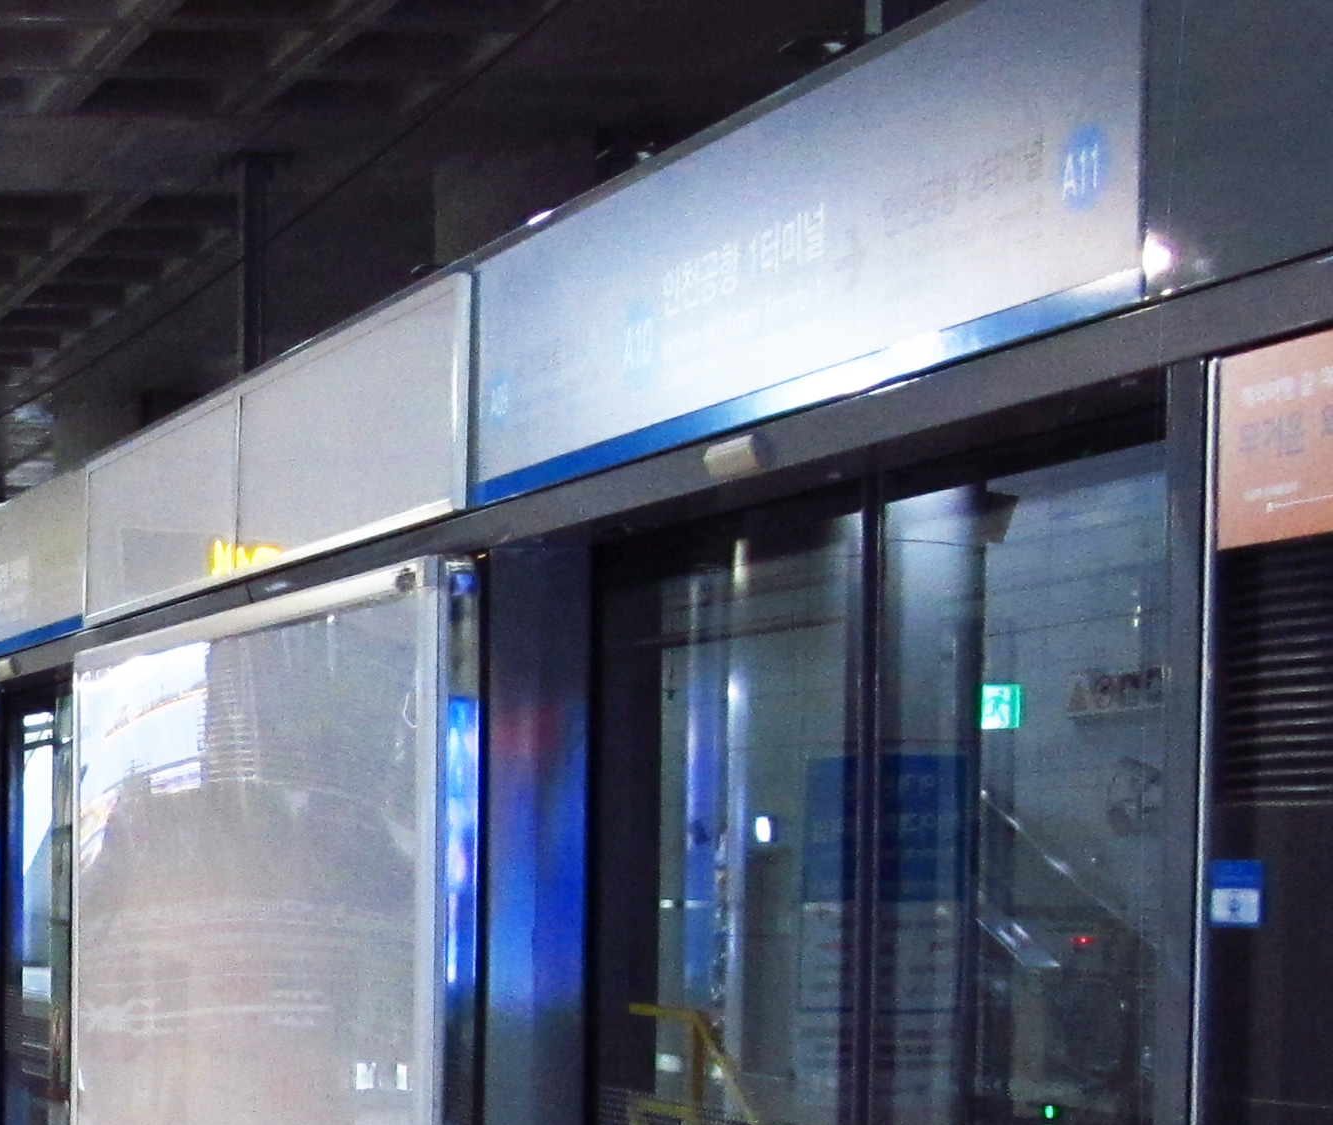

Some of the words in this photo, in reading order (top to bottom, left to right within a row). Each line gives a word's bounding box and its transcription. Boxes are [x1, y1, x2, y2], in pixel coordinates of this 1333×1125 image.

[1062, 143, 1101, 200] A11
[663, 241, 741, 319] 인천공항
[748, 203, 826, 276] 1터미널
[623, 318, 656, 372] A10
